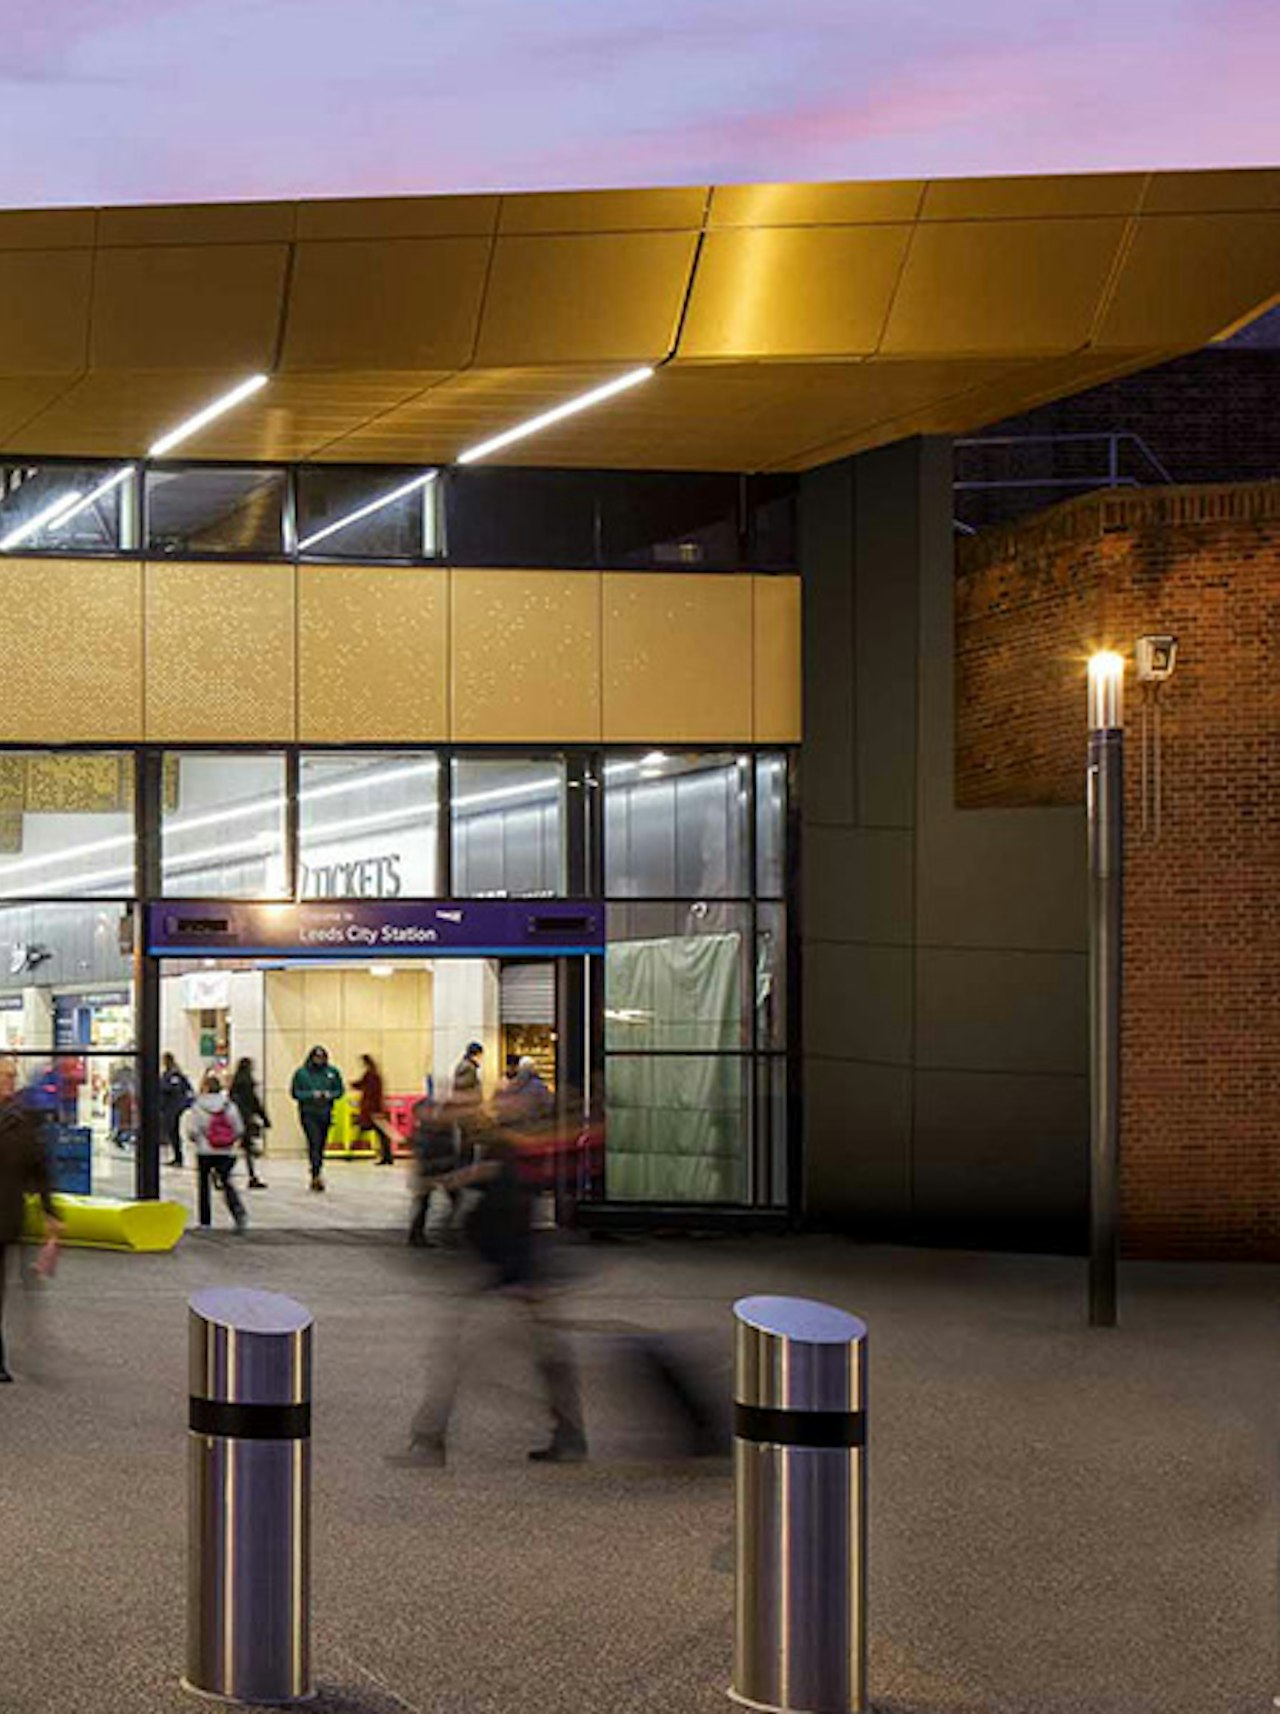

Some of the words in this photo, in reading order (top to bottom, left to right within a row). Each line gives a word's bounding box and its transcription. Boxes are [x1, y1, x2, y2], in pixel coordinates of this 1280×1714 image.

[311, 853, 401, 898] TICKETS
[299, 926, 344, 942] Leeds
[346, 925, 379, 944] City
[381, 924, 437, 942] Station
